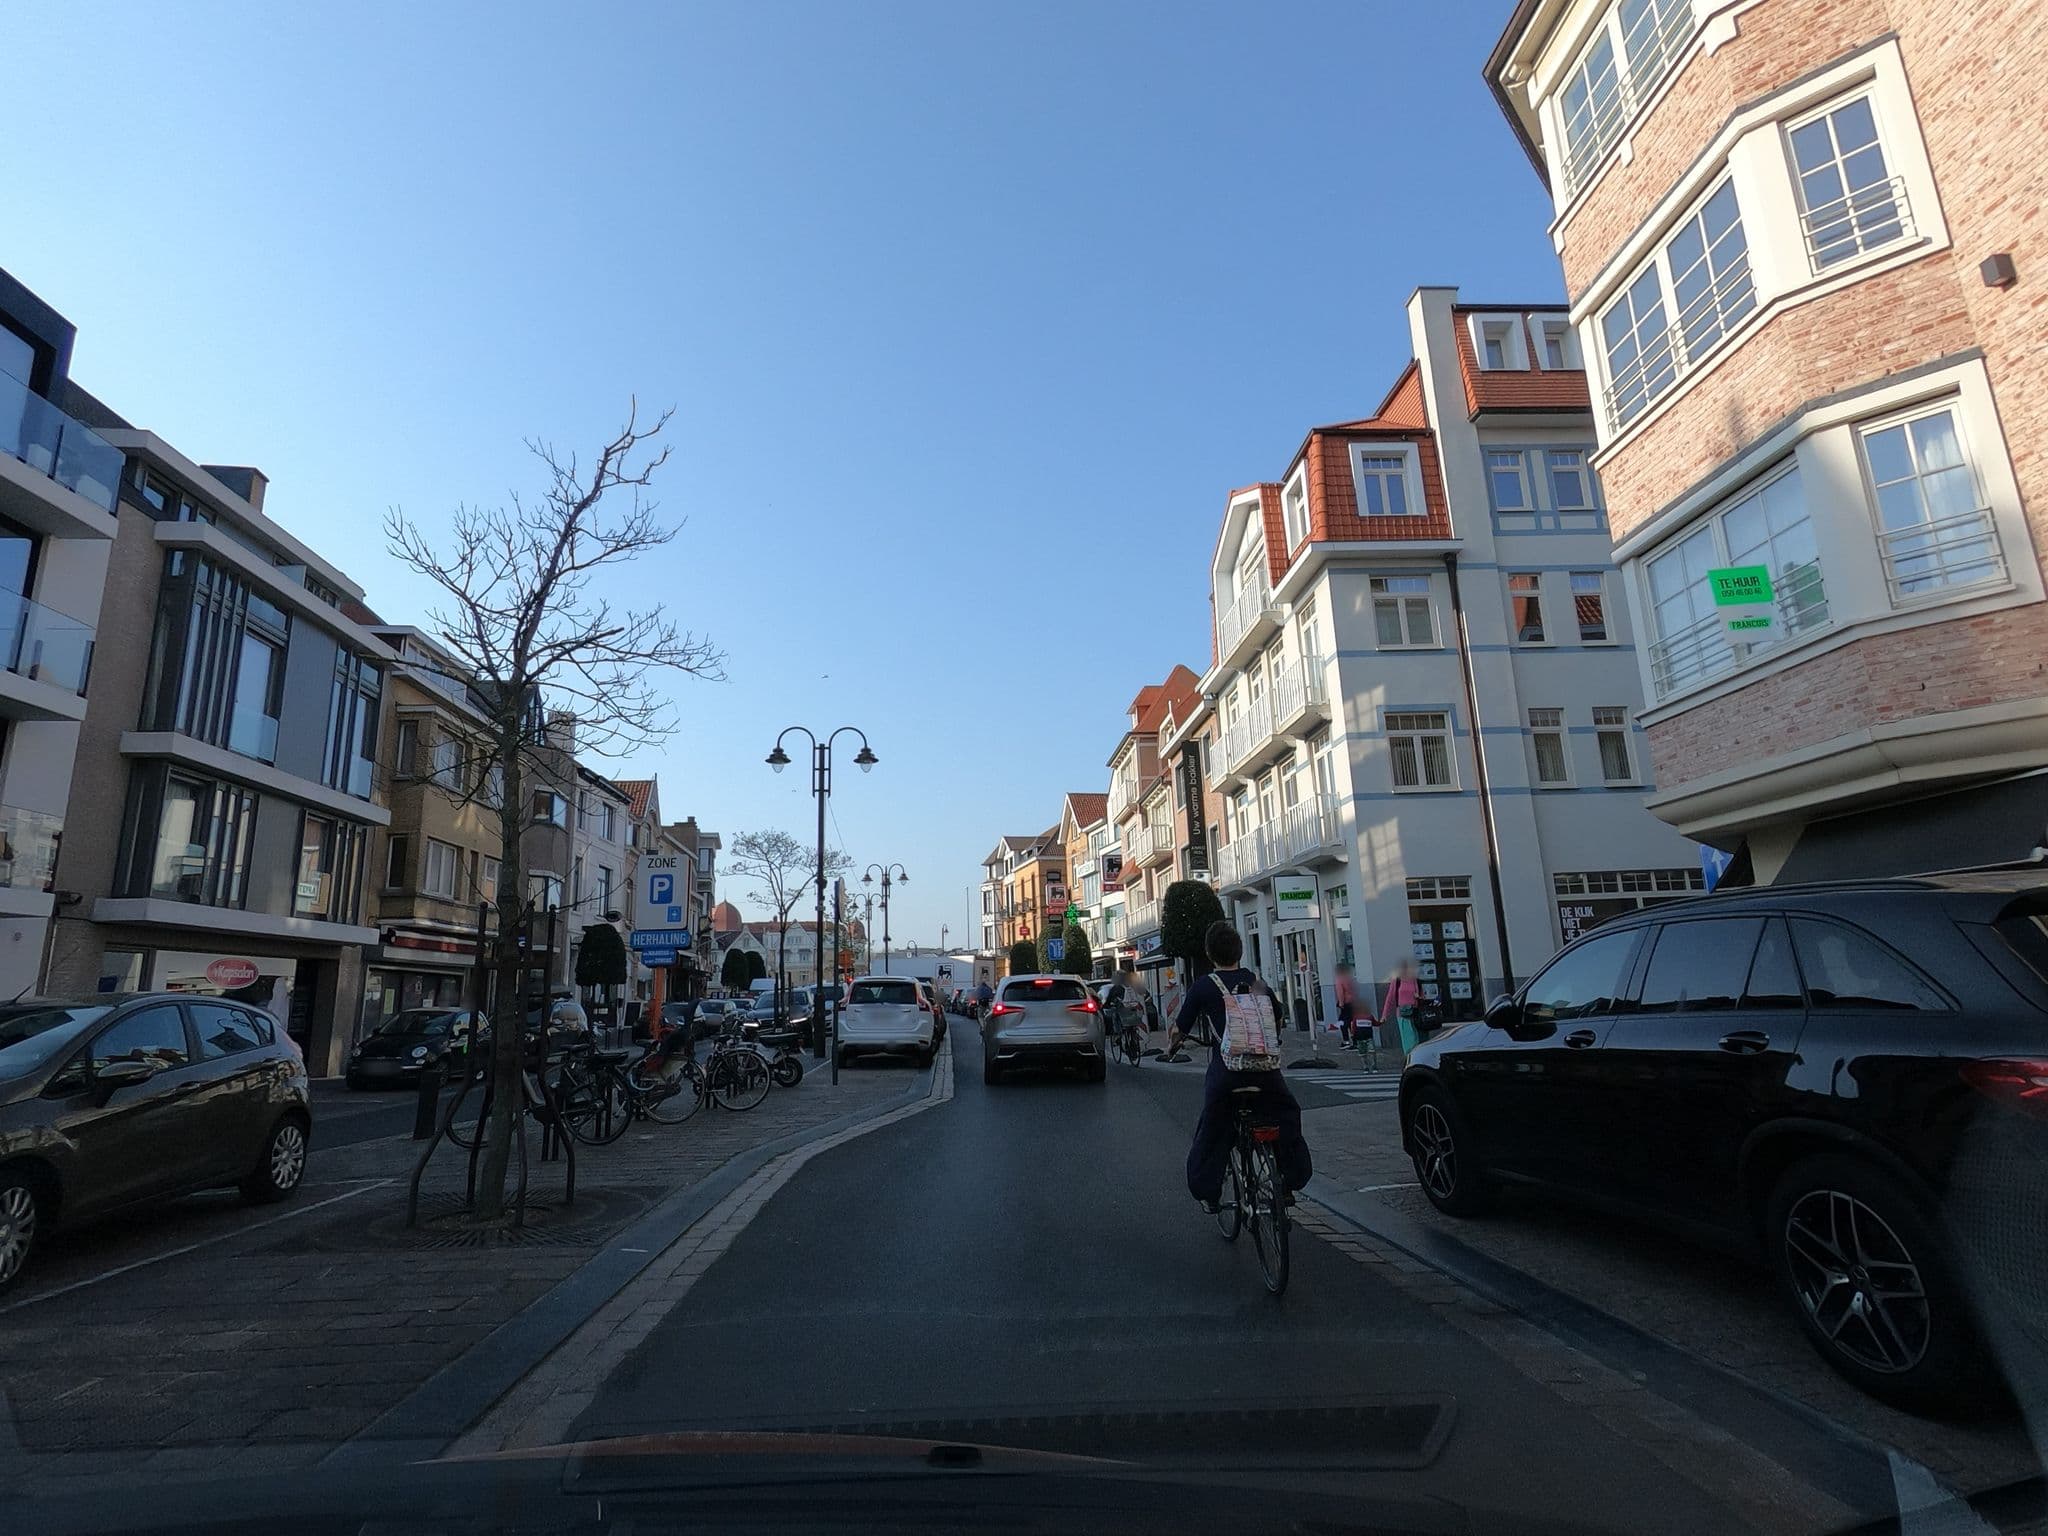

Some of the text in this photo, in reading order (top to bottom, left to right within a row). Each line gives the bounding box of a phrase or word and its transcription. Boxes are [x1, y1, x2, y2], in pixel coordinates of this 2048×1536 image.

[1718, 576, 1760, 588] TE HUUR
[1193, 820, 1201, 835] Uw
[647, 857, 678, 869] ZONE
[653, 877, 670, 902] P
[1561, 907, 1573, 917] DE
[1562, 918, 1580, 928] MET
[633, 934, 687, 946] HERHALING
